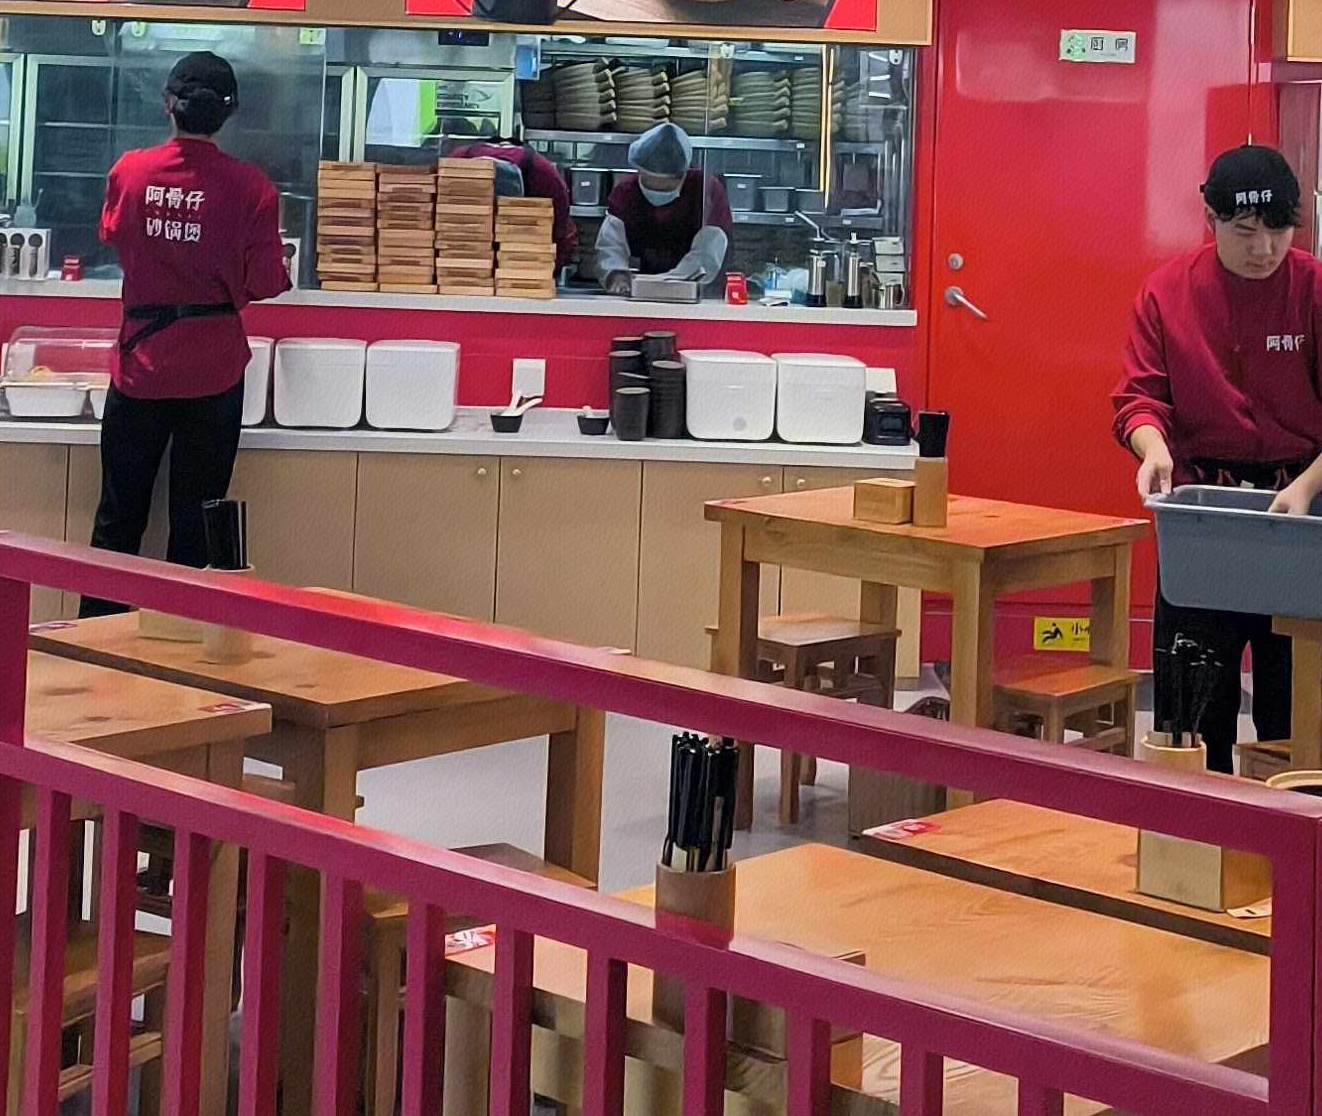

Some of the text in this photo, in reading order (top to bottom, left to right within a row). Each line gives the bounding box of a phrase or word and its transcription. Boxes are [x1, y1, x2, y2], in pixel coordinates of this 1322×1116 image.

[145, 185, 206, 211] 阿骨仔
[1235, 189, 1273, 205] 阿骨仔
